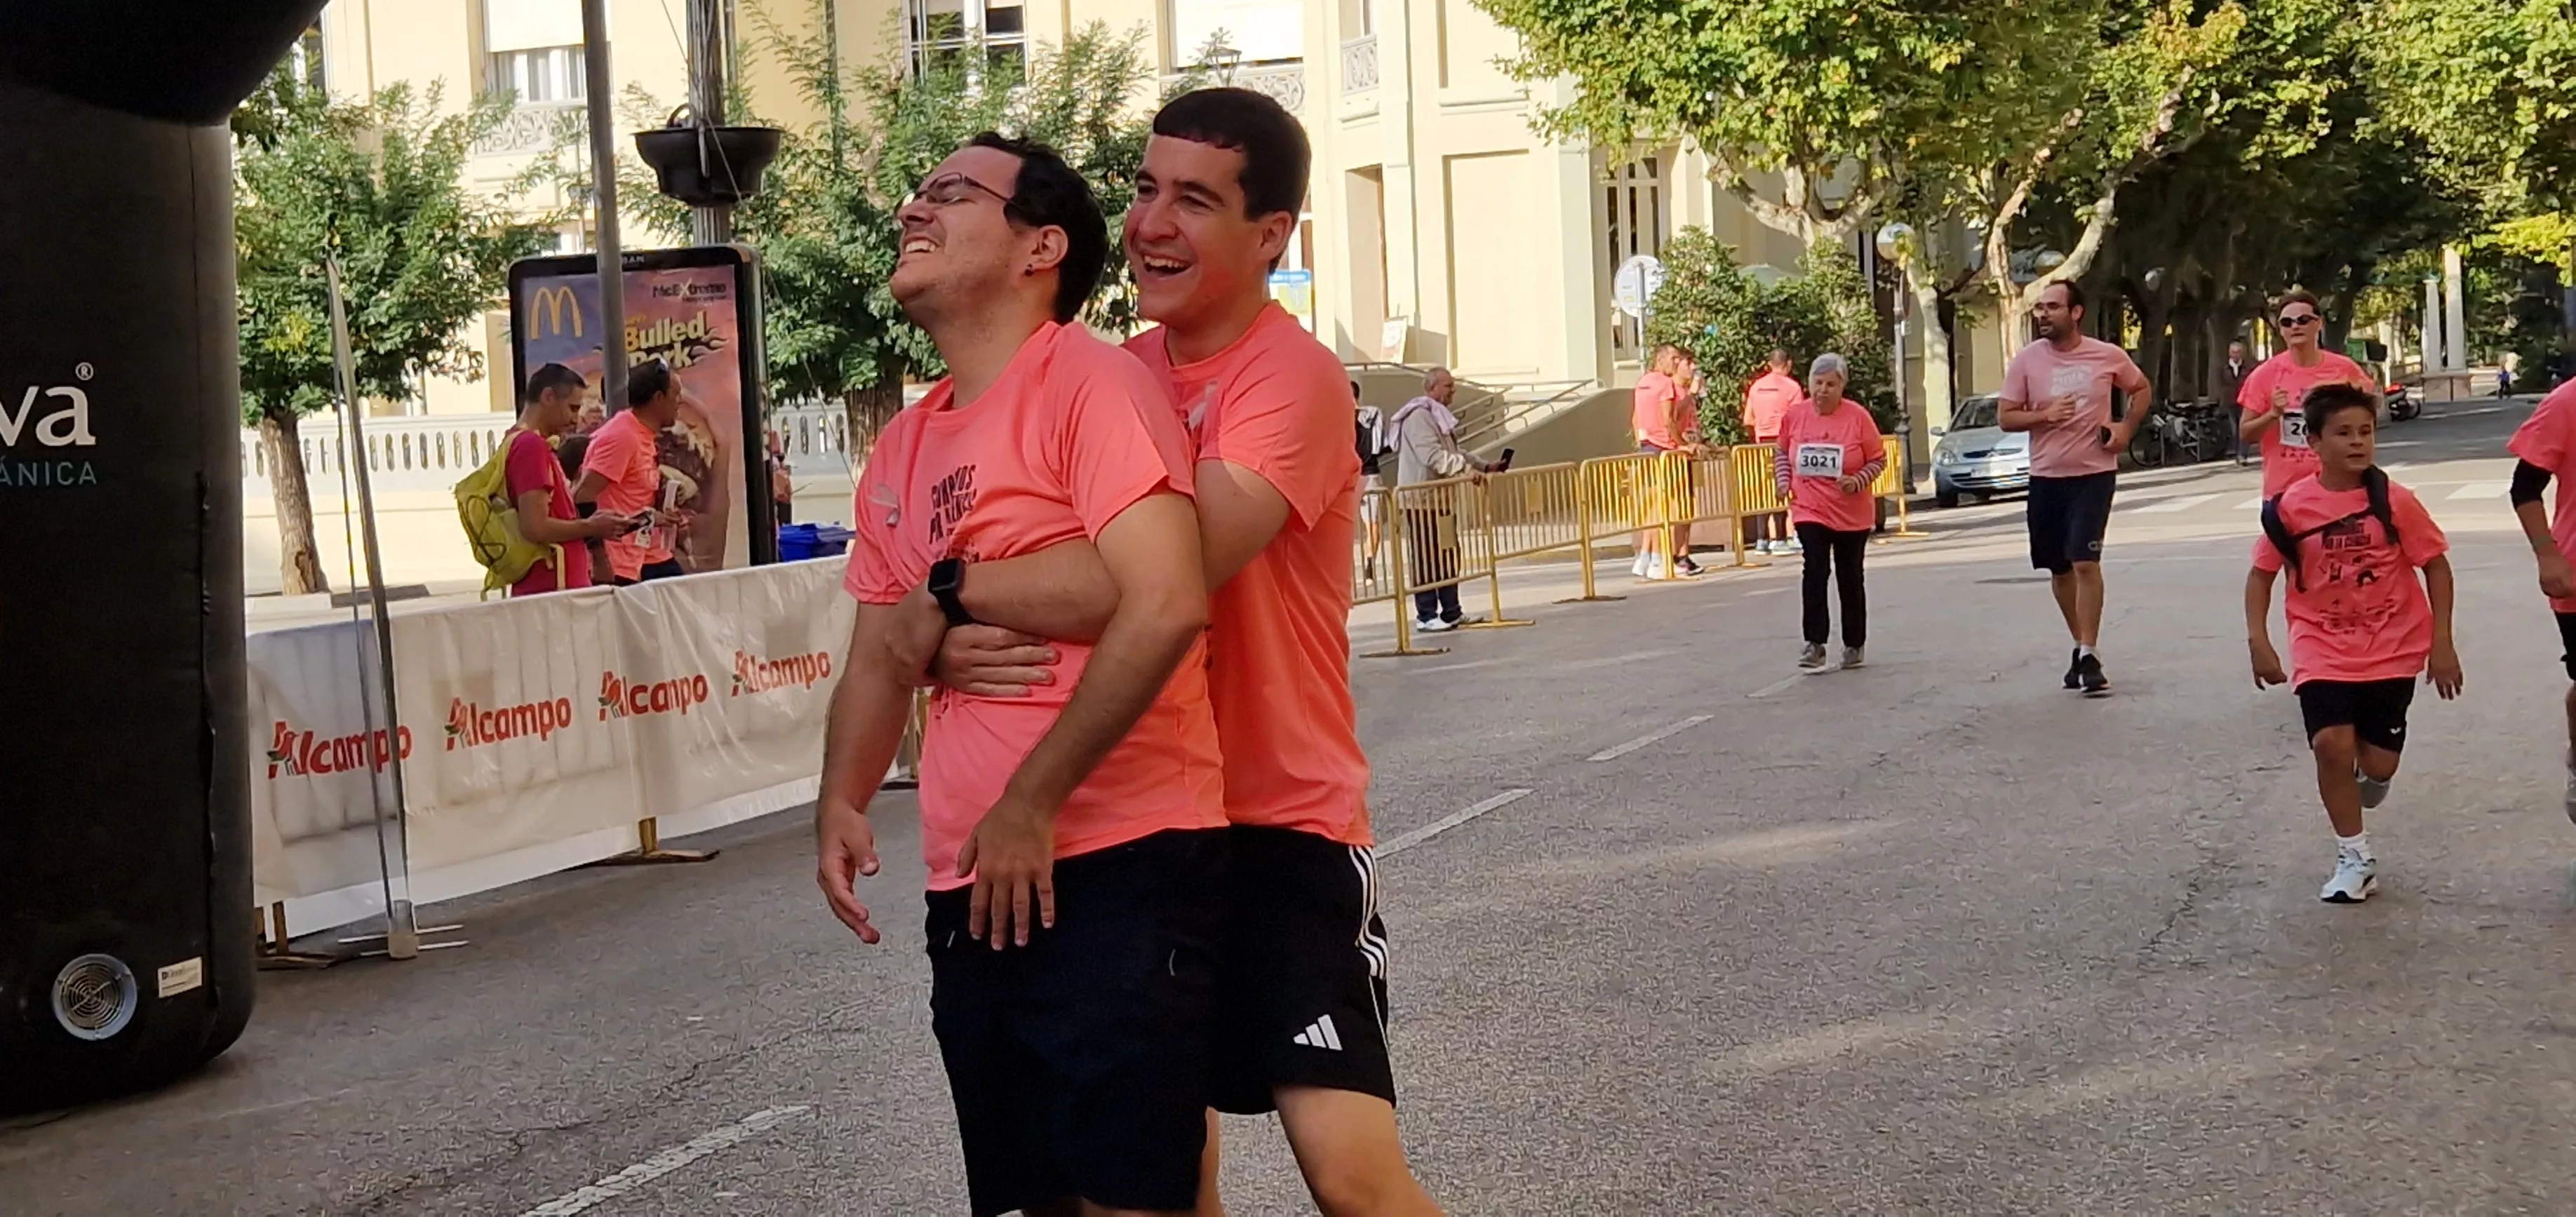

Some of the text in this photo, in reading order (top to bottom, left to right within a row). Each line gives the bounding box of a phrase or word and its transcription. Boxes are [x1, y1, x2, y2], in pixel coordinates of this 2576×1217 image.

[1801, 455, 1837, 469] 3021
[732, 650, 831, 697] Alcampo
[444, 697, 572, 751] Alcampo
[267, 721, 412, 779] Alcampo
